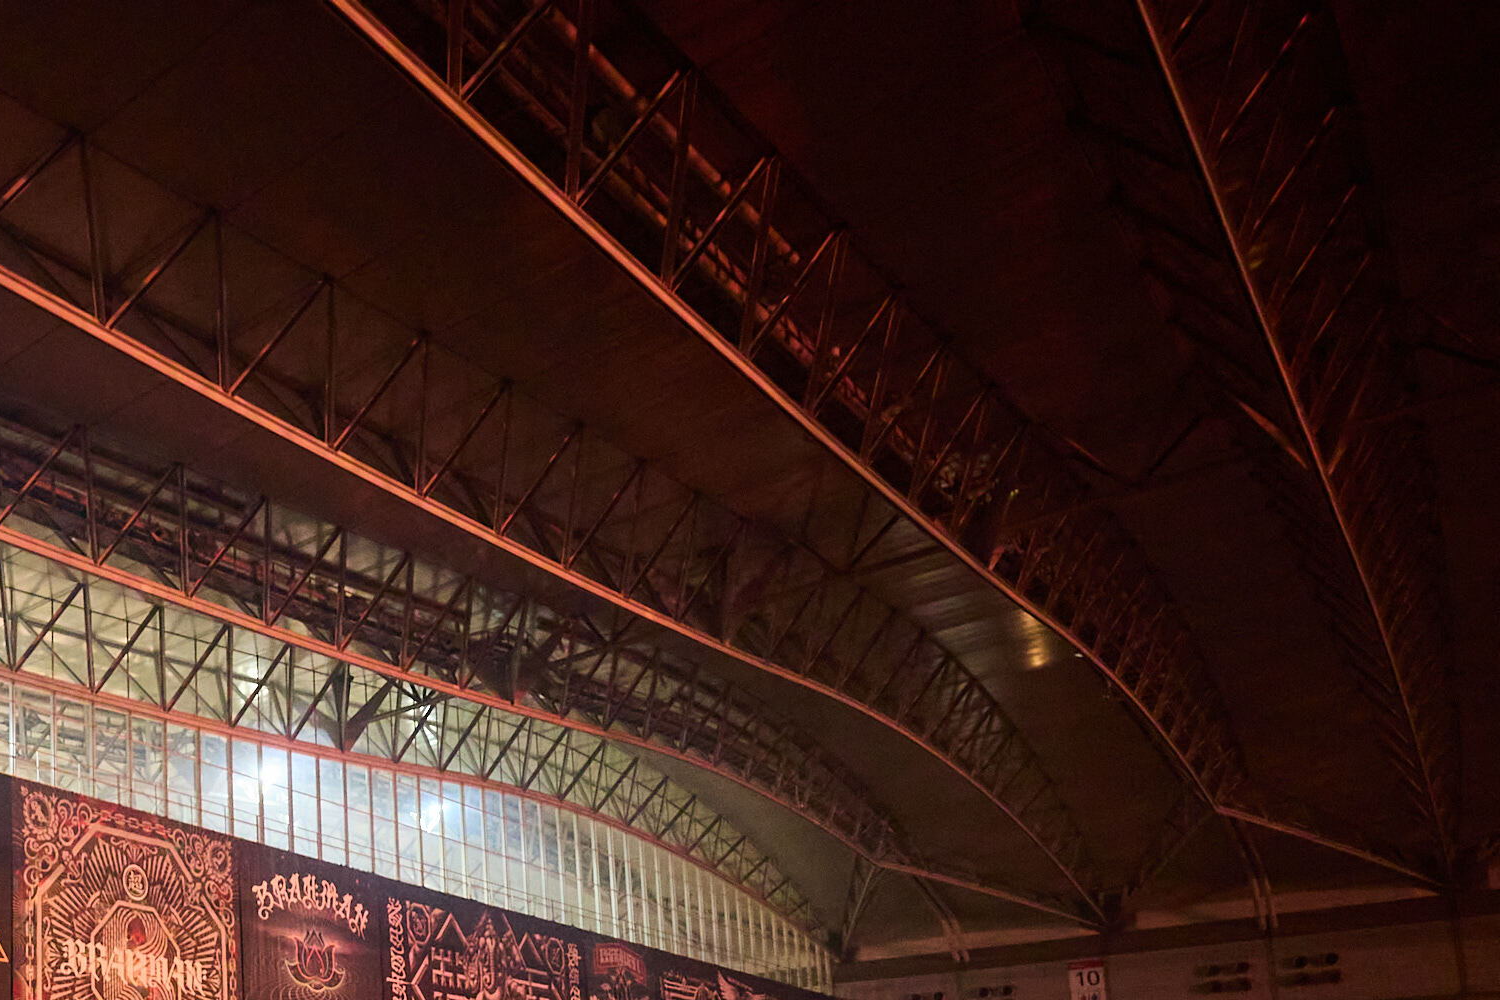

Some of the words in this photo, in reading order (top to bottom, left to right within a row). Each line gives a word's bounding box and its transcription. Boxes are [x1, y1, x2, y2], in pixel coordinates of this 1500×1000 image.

[251, 872, 370, 941] BRAHMAN
[58, 937, 209, 997] BRAHMAN
[1076, 970, 1101, 987] 10
